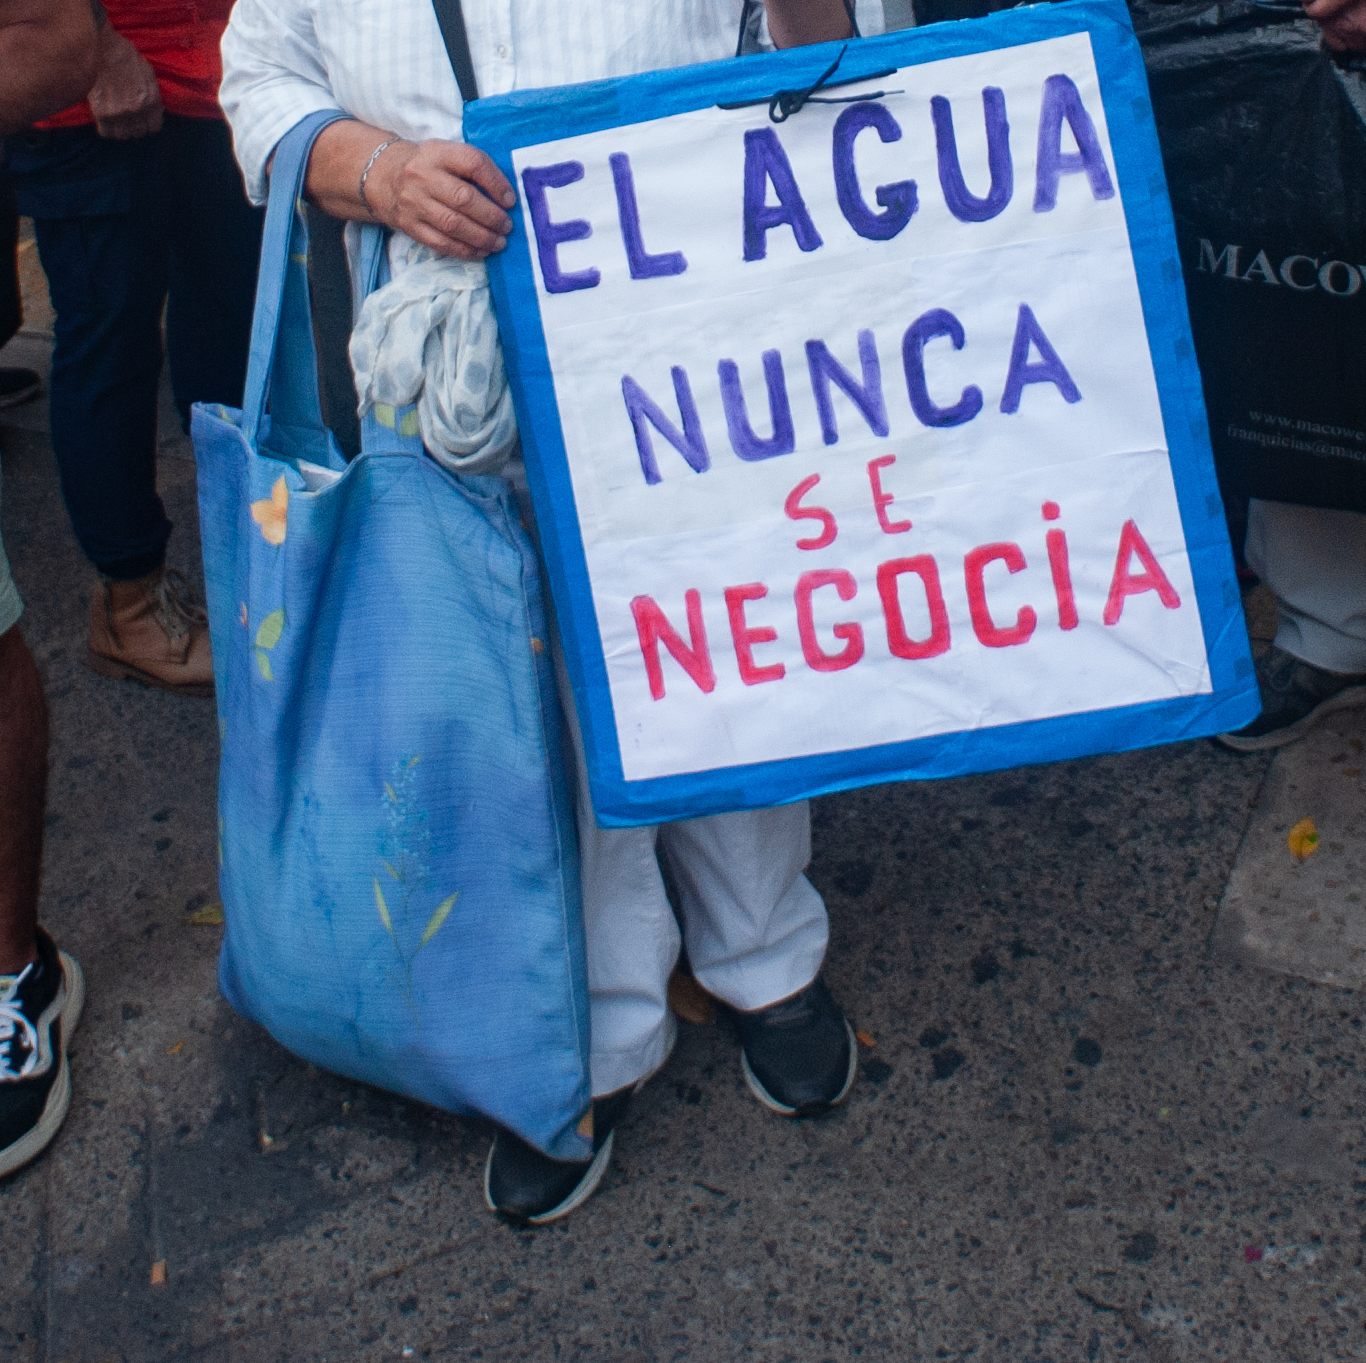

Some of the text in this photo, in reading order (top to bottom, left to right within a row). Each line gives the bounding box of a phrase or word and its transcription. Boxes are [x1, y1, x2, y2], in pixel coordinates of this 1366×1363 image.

[522, 72, 1117, 294] EL AGUA
[620, 301, 1083, 486] NUNCA
